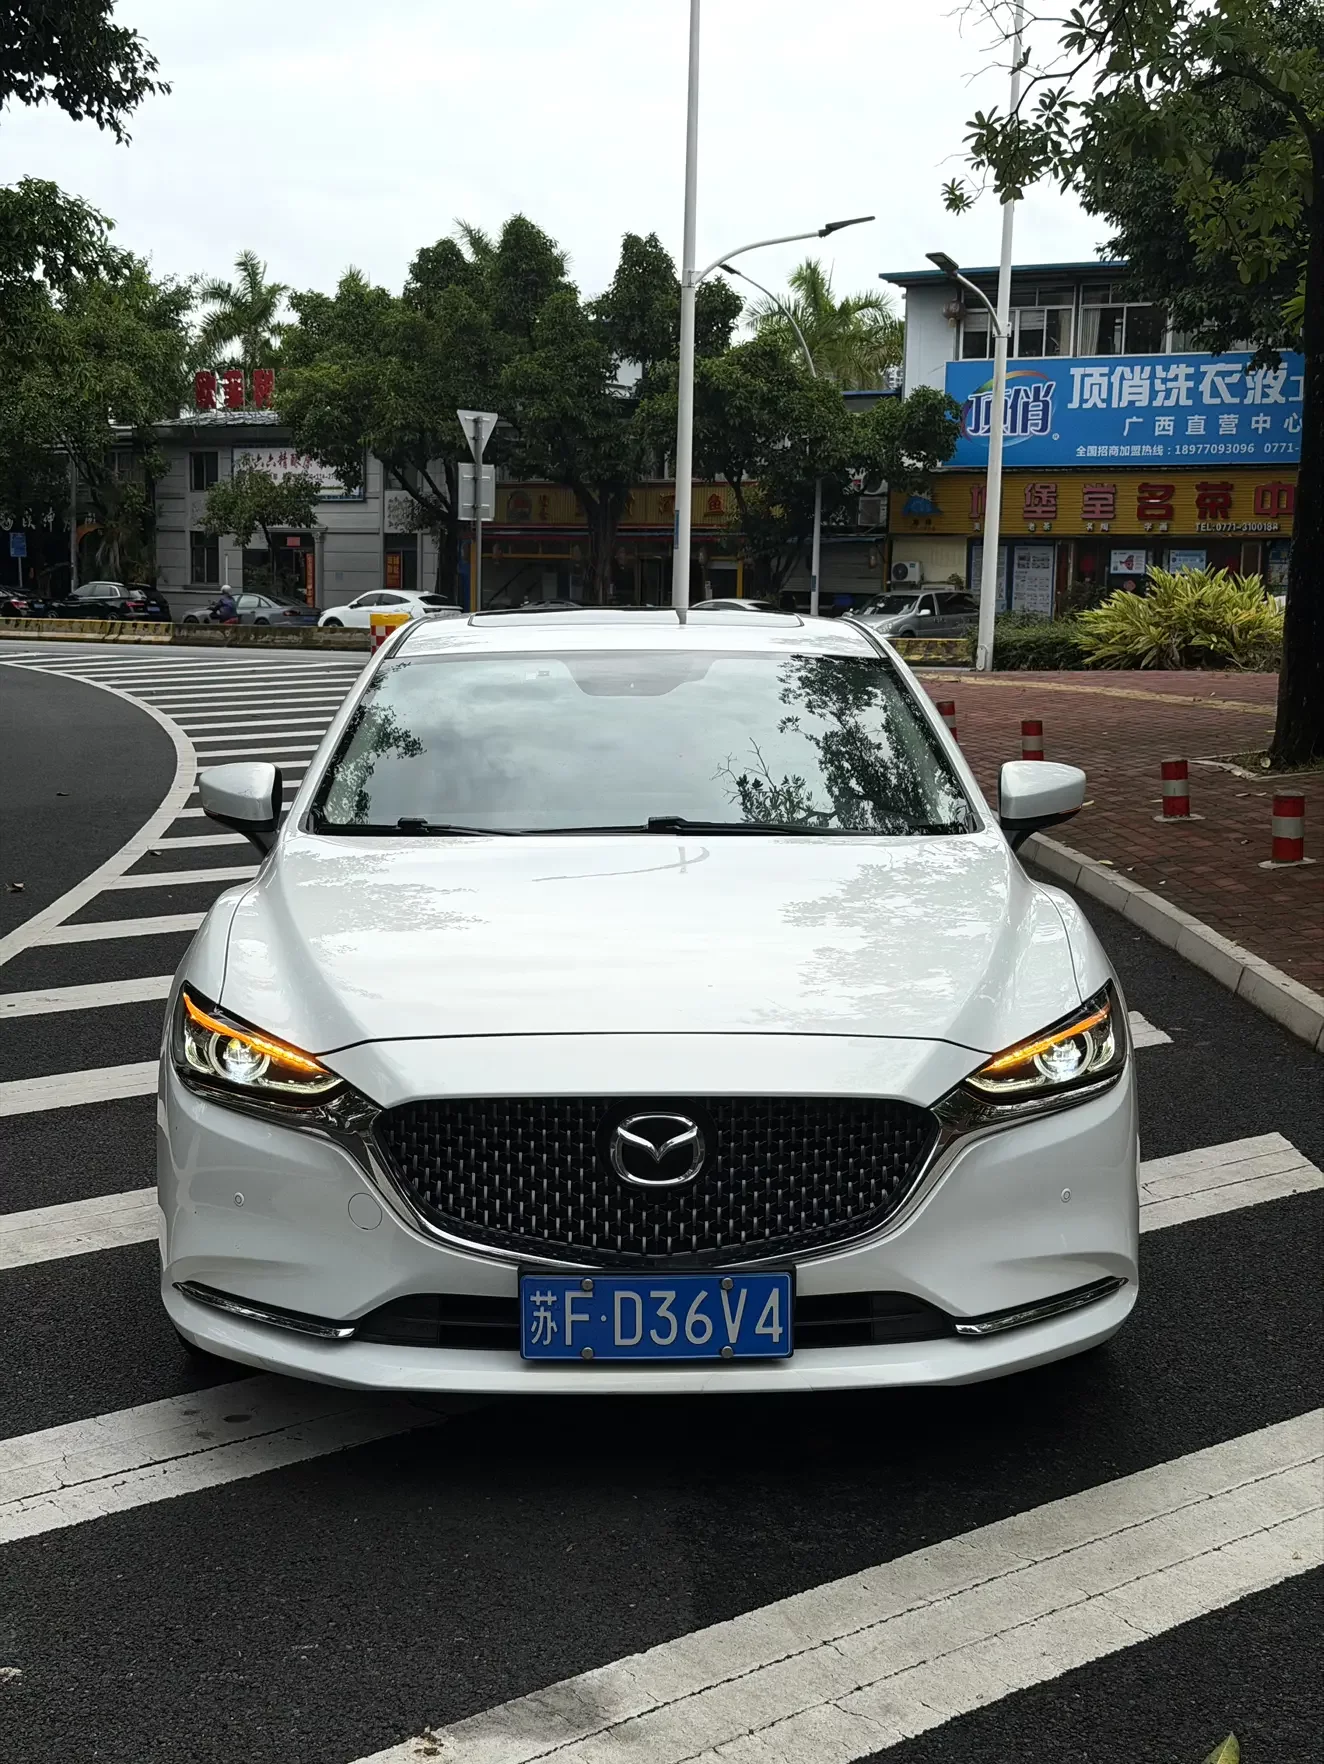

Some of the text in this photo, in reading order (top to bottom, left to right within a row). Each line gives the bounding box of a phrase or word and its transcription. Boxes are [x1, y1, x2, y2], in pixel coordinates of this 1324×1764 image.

[1123, 413, 1303, 437] 广西直营中心
[530, 1288, 783, 1346] 苏F·D36V4
